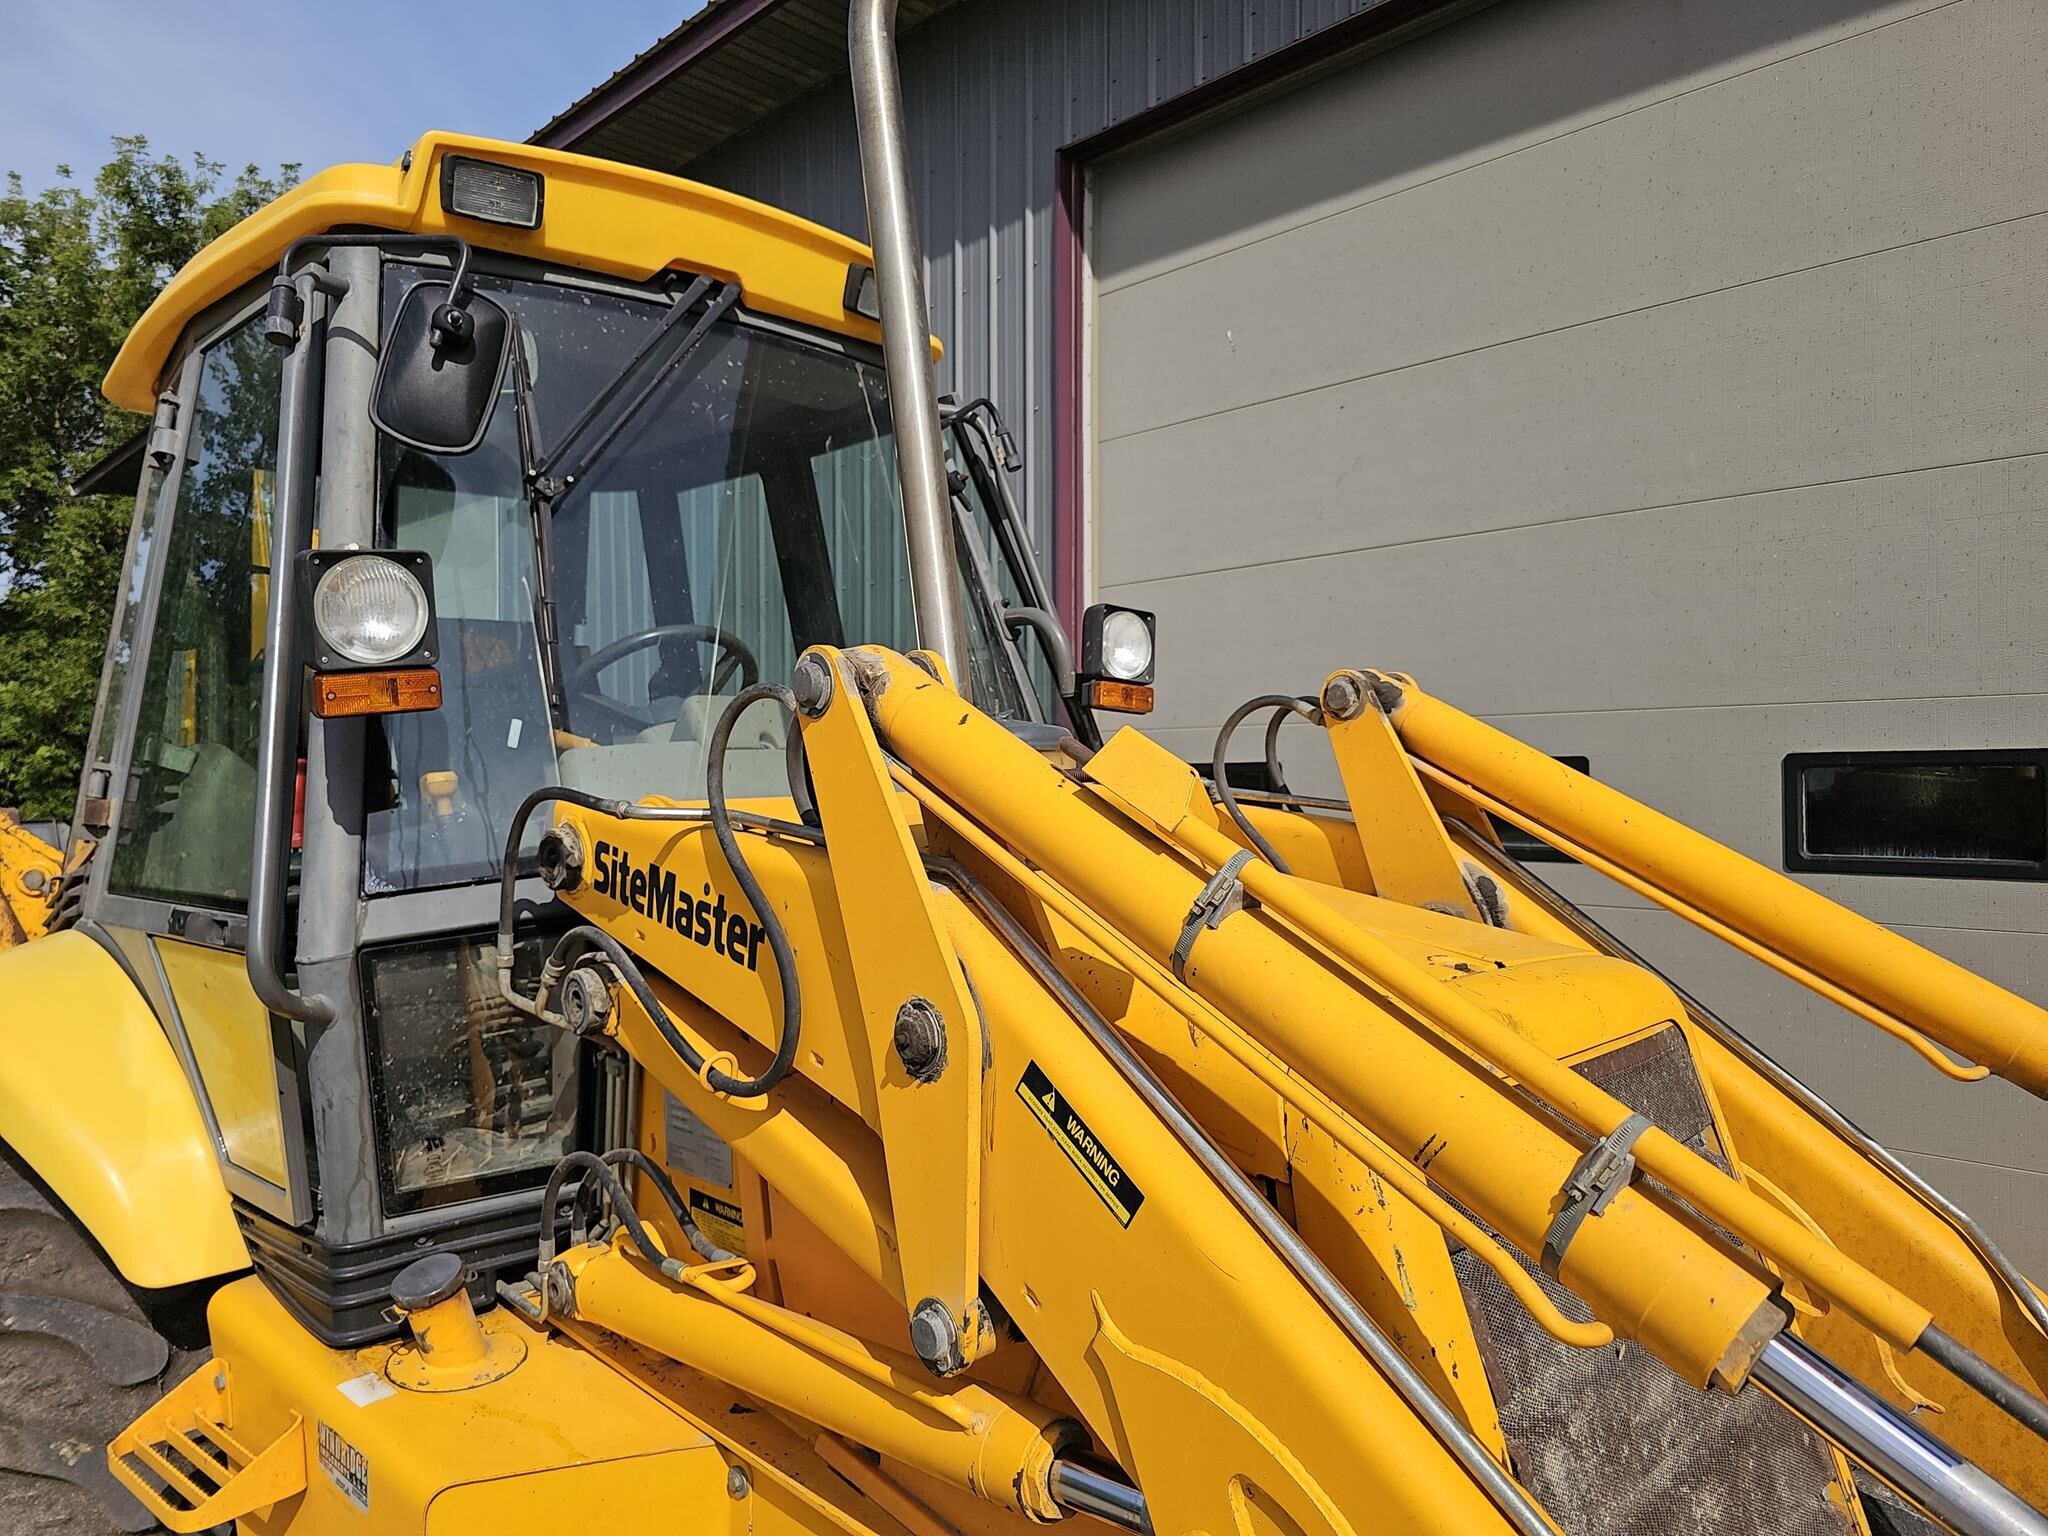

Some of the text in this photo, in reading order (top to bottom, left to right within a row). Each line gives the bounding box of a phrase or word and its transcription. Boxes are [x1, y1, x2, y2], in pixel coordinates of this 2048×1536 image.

[594, 840, 766, 972] SiteMaster
[1066, 1115, 1120, 1187] WARNING
[714, 1201, 744, 1222] WARNING
